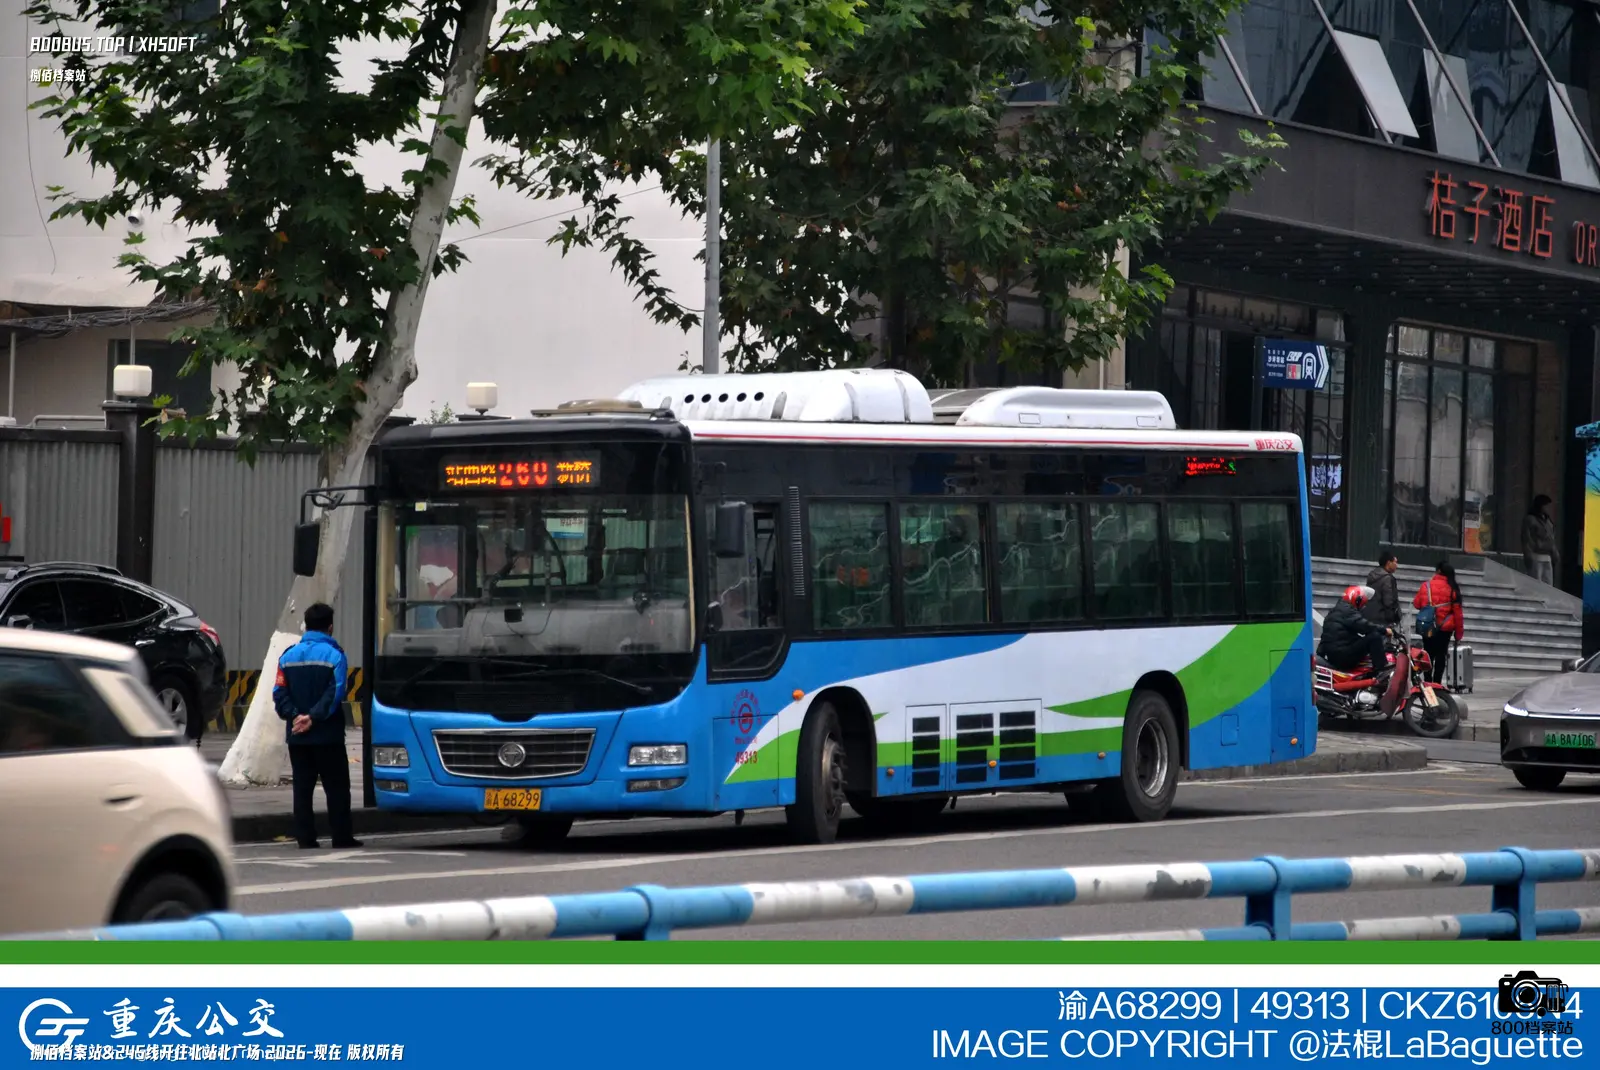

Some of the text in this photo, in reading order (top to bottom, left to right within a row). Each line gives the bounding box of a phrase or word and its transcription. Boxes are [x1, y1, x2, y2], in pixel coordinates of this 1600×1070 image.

[1428, 168, 1556, 258] 桔子酒店
[1255, 438, 1295, 451] 重庆公交
[499, 461, 548, 486] 260
[735, 750, 759, 764] 49313
